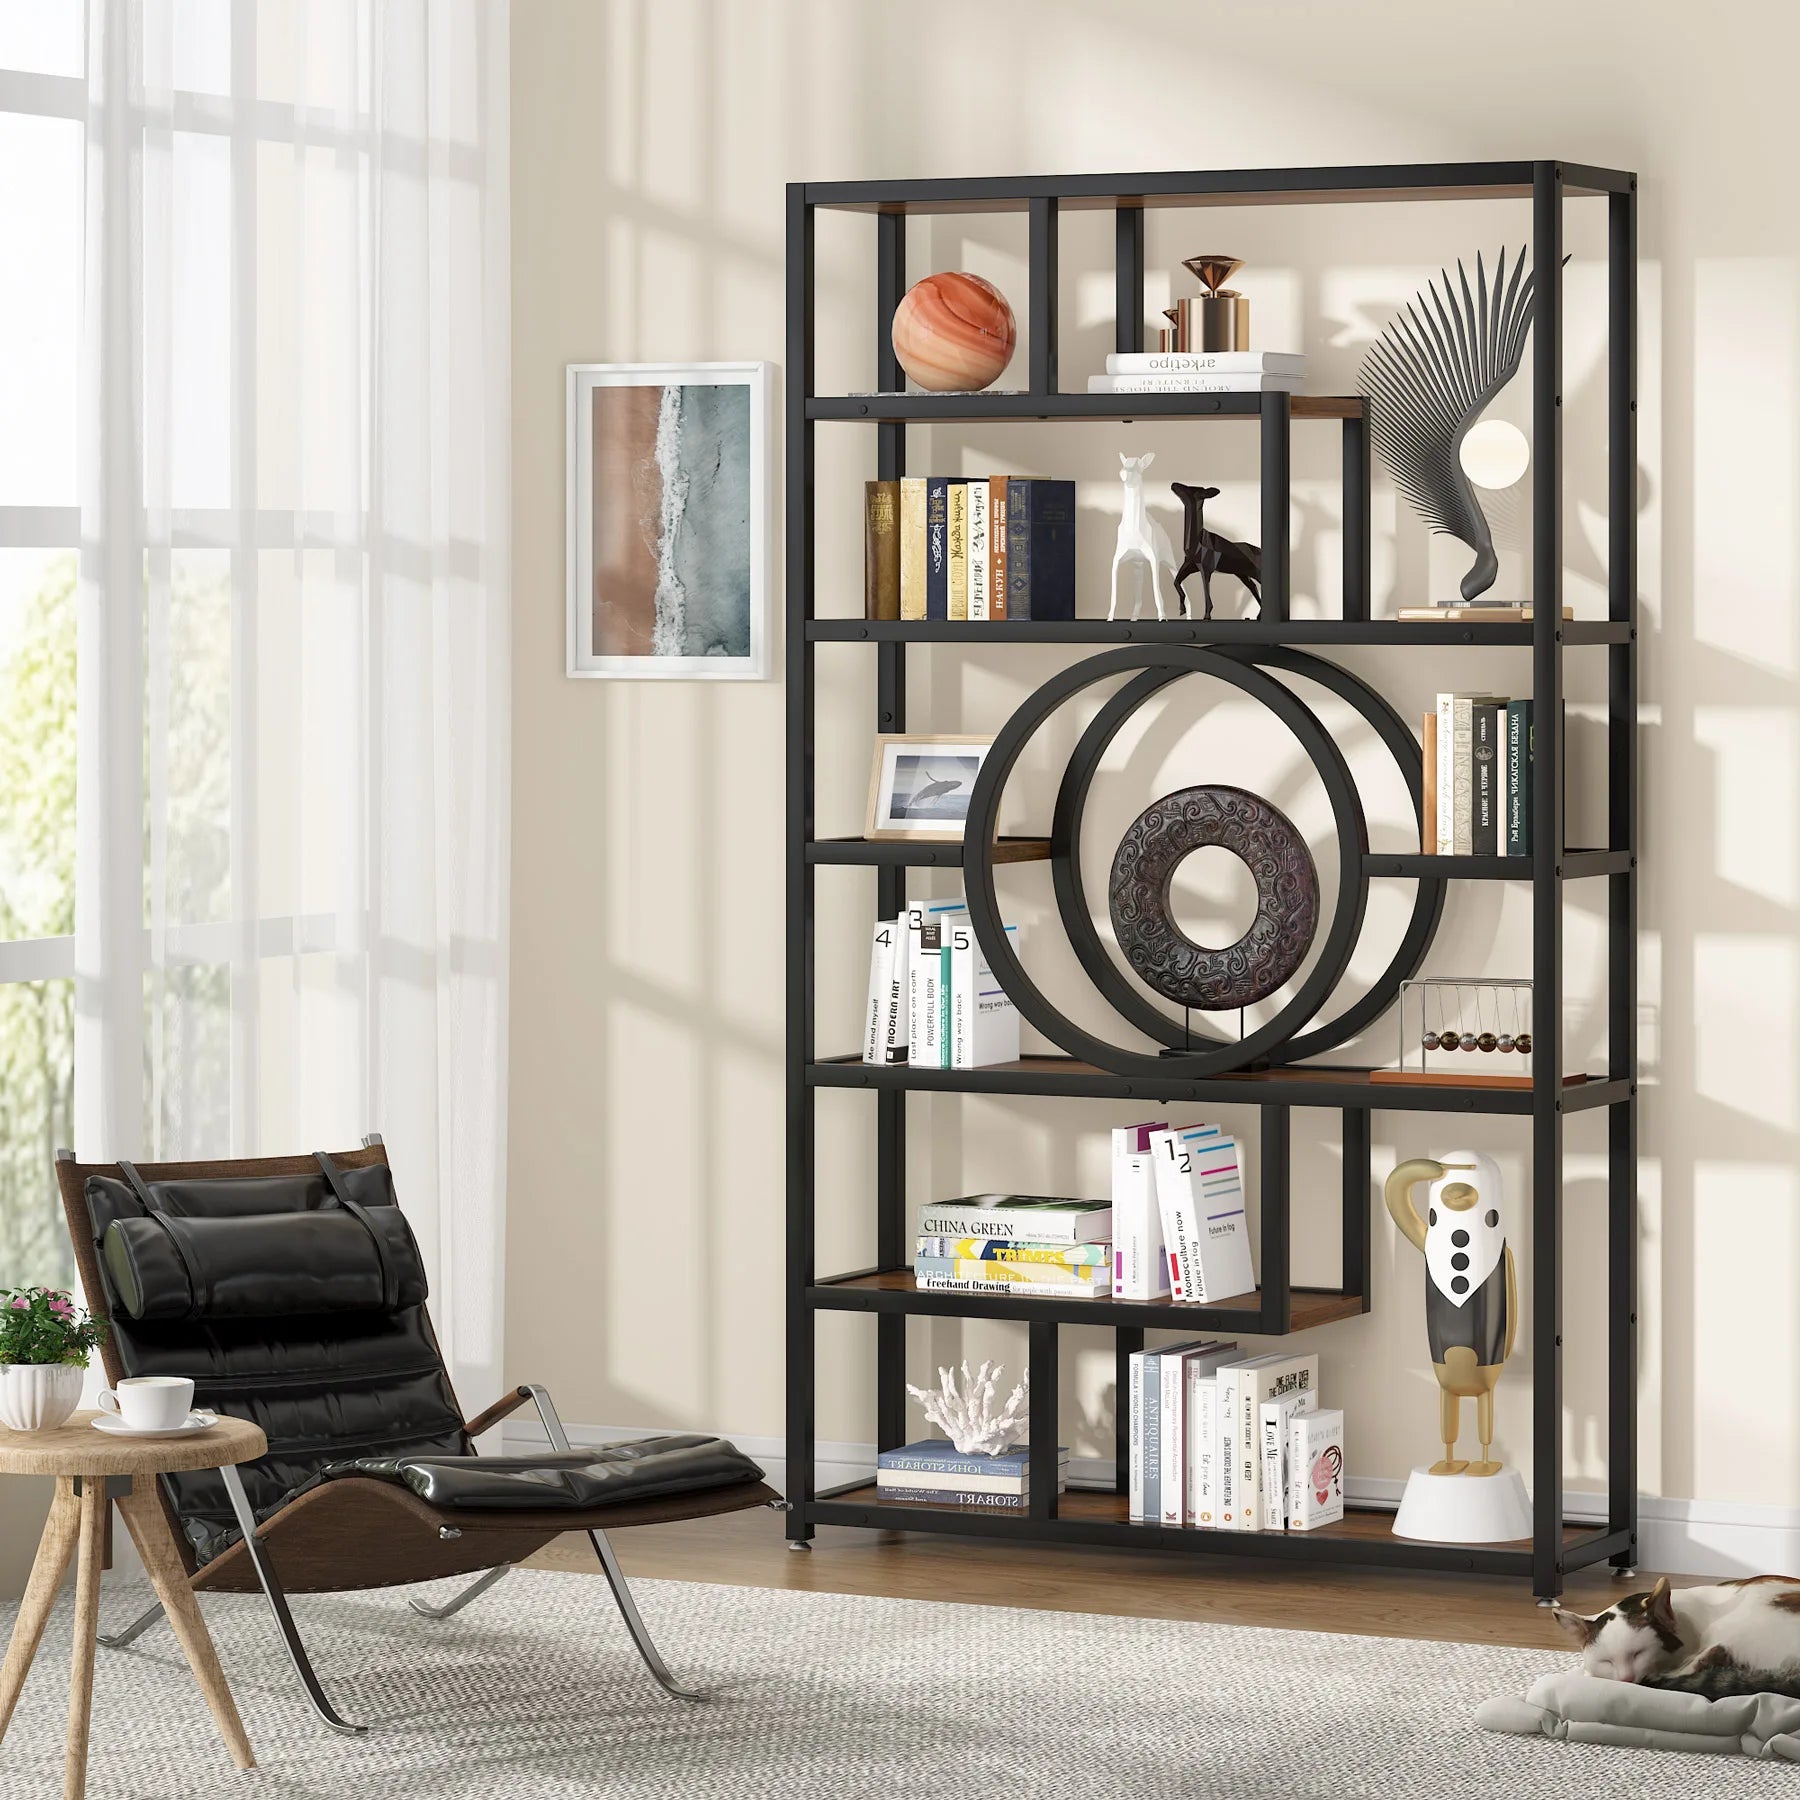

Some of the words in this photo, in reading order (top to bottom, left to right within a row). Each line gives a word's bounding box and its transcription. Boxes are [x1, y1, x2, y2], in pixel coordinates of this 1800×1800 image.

[1149, 357, 1217, 372] arketipo
[952, 490, 964, 523] жизни
[950, 524, 964, 559] Жажда
[1511, 714, 1519, 744] БЕЗДНА
[1480, 764, 1488, 790] ЧЕРНОЕ
[1511, 746, 1519, 794] ЧИКАГСКАЯ
[1511, 796, 1520, 828] Брэдбери
[1511, 830, 1519, 842] Рэй
[908, 910, 923, 930] 3
[875, 929, 892, 948] 4
[954, 932, 970, 950] 5
[892, 980, 900, 999] ART
[926, 977, 934, 998] BODY
[912, 996, 916, 1008] on
[979, 1000, 993, 1010] Wrong
[994, 1000, 1004, 1009] way
[888, 1002, 898, 1045] MODERN
[926, 1001, 934, 1047] POWERFULL
[868, 1046, 874, 1060] Me
[1164, 1138, 1175, 1160] 1
[1178, 1152, 1192, 1174] 2
[924, 1219, 968, 1234] CHINA
[970, 1222, 1014, 1236] GREEN
[1176, 1210, 1184, 1232] now
[1208, 1226, 1222, 1235] Future
[1180, 1235, 1194, 1298] Monoculture
[1194, 1258, 1200, 1267] in
[917, 1270, 1016, 1283] ARCHITECTURE
[926, 1278, 970, 1290] Freehand
[972, 1281, 1010, 1293] Drawing
[1196, 1269, 1204, 1296] Future
[1276, 1376, 1284, 1386] ONE
[1285, 1372, 1297, 1384] FLEW
[1298, 1370, 1309, 1381] OVER
[1222, 1386, 1234, 1402] Kesey
[1268, 1386, 1278, 1398] THE
[1298, 1380, 1309, 1390] NEST
[1224, 1407, 1232, 1418] Ken
[1149, 1397, 1158, 1480] ANTIQUAIRES
[1224, 1436, 1232, 1447] NEST
[1202, 1454, 1211, 1464] Eat
[1224, 1474, 1232, 1486] OVER
[1224, 1486, 1232, 1498] FLEW
[1224, 1498, 1232, 1506] ONE
